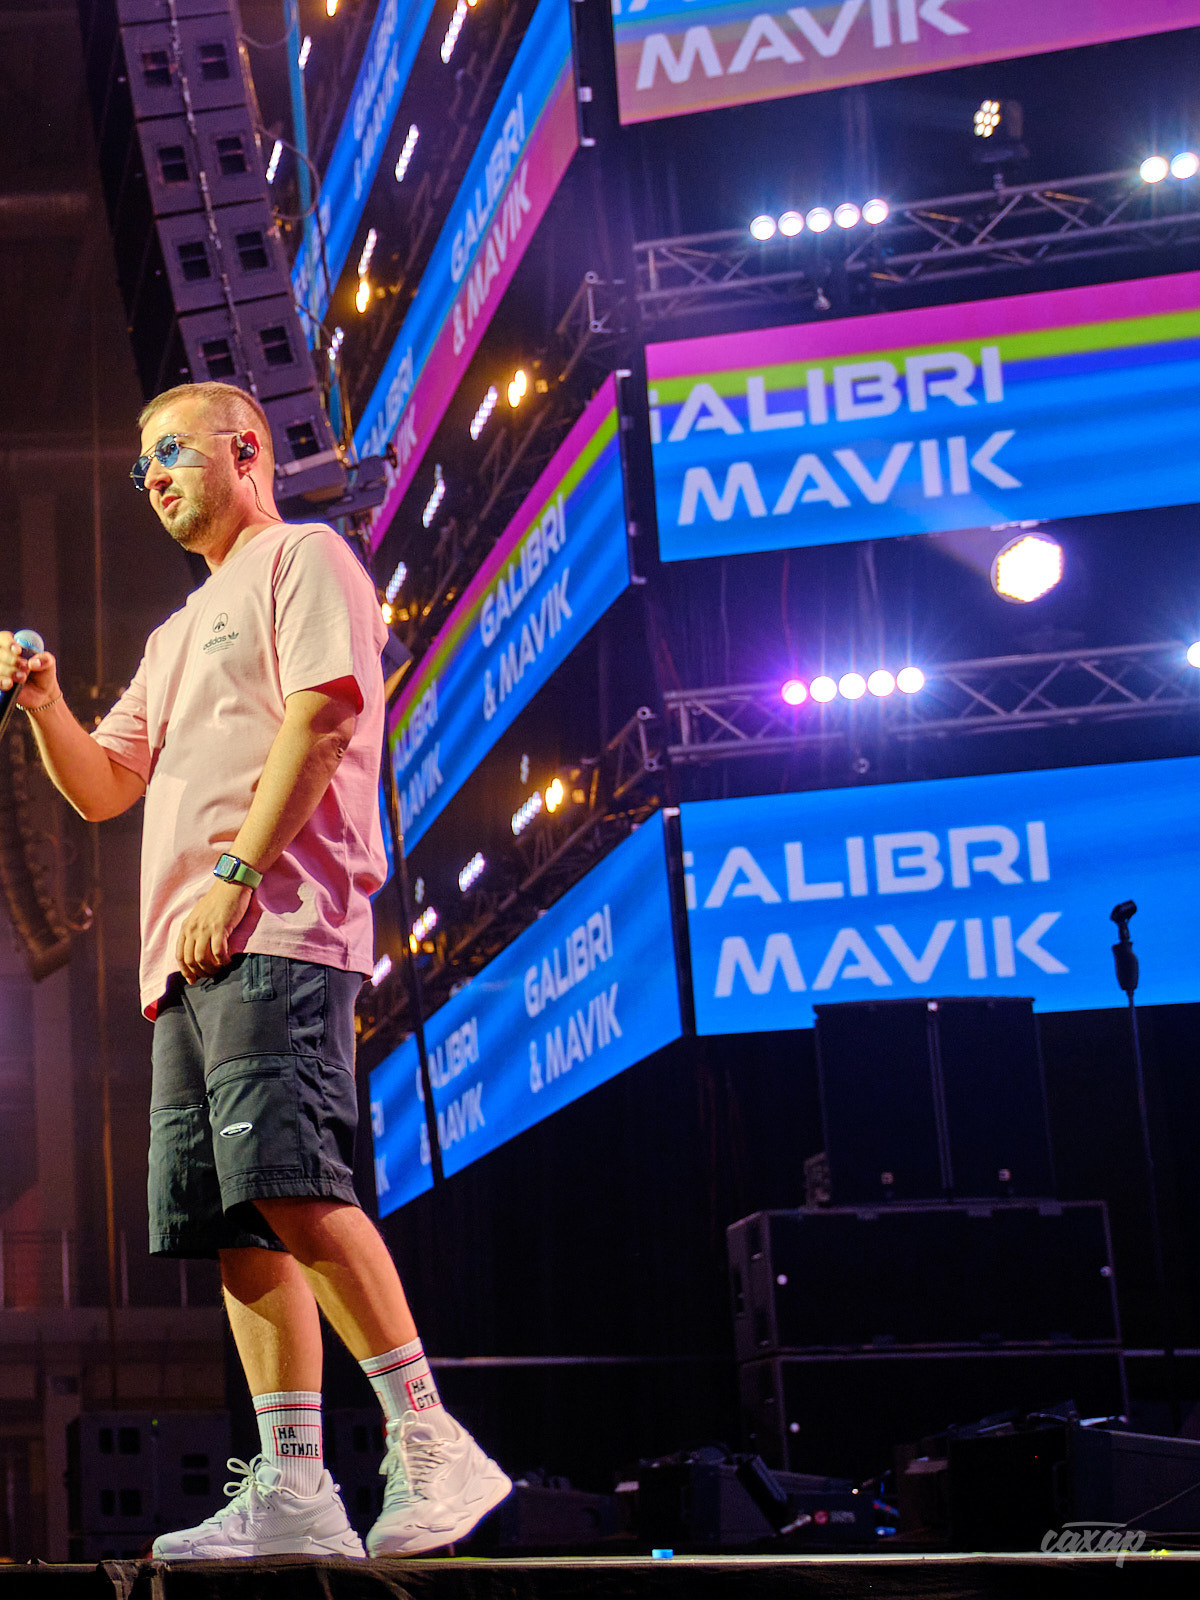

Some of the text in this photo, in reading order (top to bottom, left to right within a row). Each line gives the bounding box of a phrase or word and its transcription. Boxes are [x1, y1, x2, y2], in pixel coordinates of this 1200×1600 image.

[636, 0, 970, 90] MAVIK
[451, 93, 526, 283] GALIBRI
[466, 161, 531, 330] MAVIK
[650, 346, 1004, 444] ALIBRI
[677, 430, 1023, 526] MAVIK
[480, 493, 567, 648] GALIBRI
[499, 568, 573, 702] MAVIK
[683, 821, 1050, 909] ALIBRI
[524, 904, 614, 1018] GALIBRI
[715, 911, 1069, 998] MAVIK
[545, 982, 623, 1084] MAVIK
[278, 1426, 296, 1439] НА
[281, 1443, 319, 1456] СТИЛЕ
